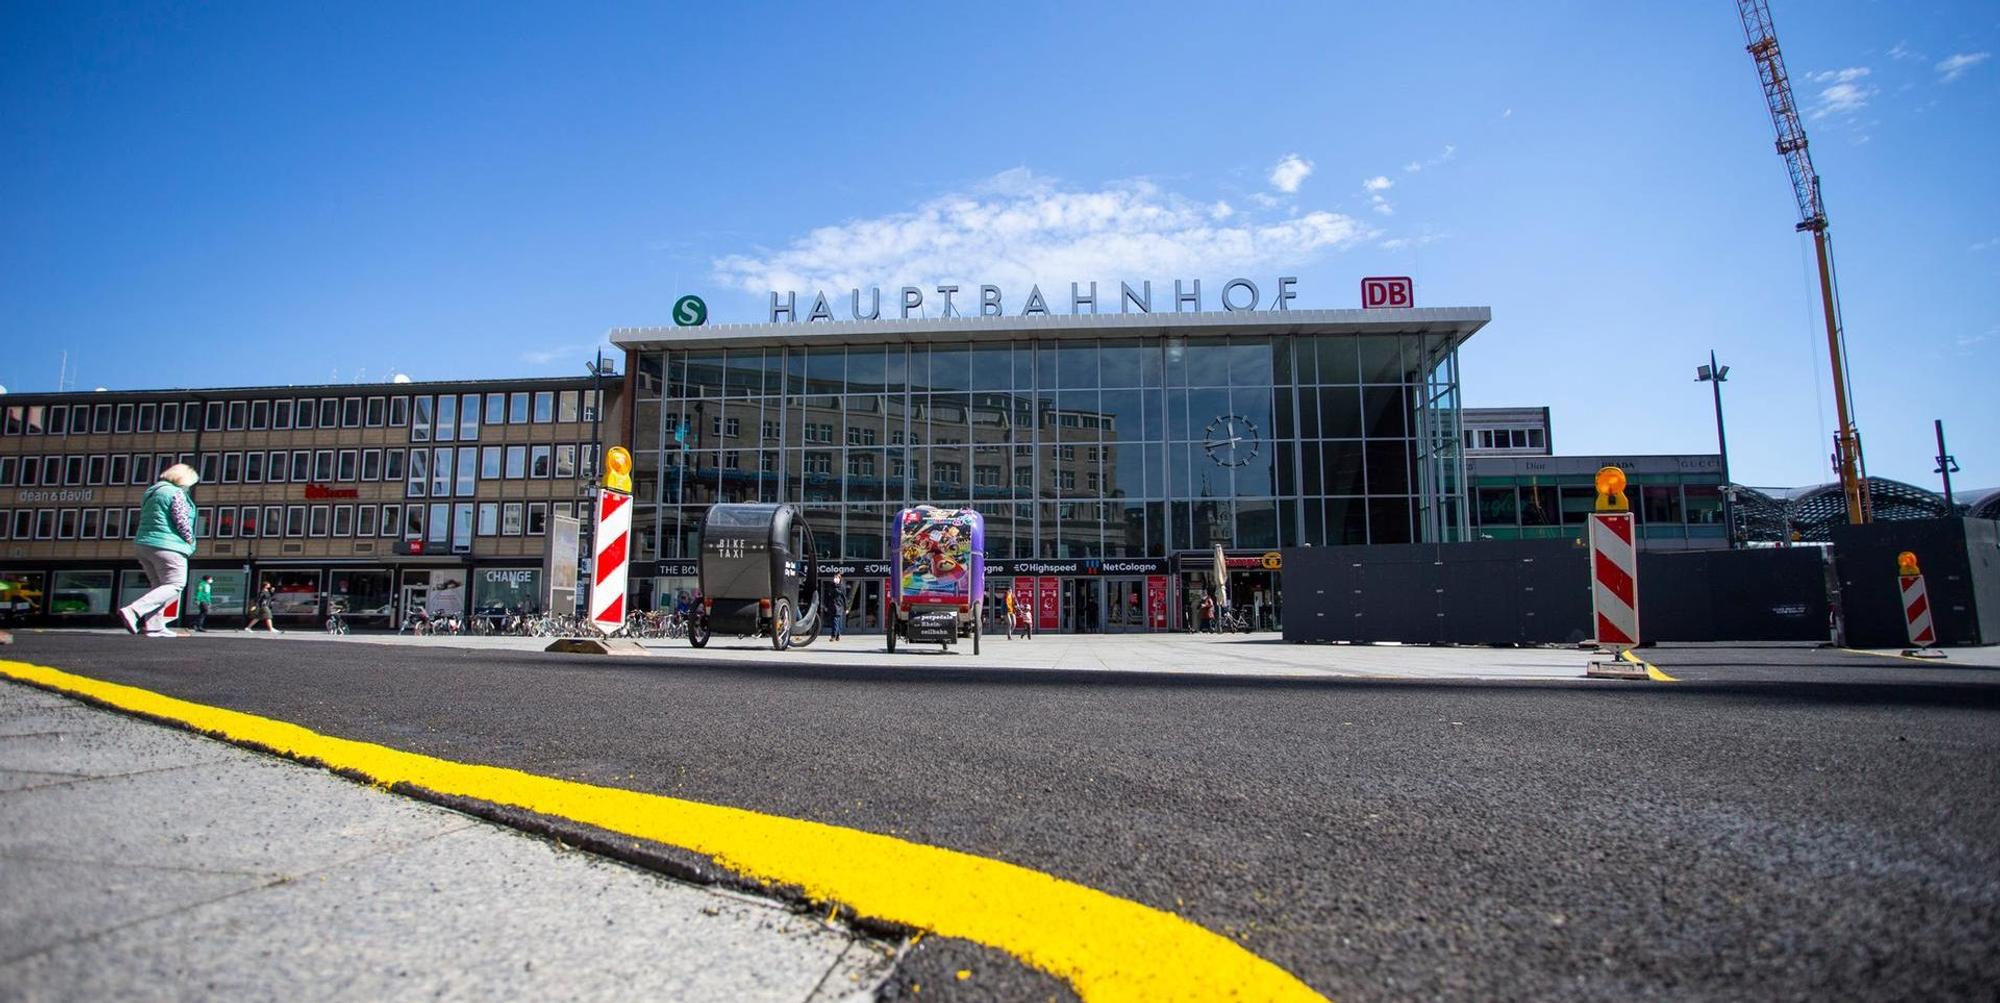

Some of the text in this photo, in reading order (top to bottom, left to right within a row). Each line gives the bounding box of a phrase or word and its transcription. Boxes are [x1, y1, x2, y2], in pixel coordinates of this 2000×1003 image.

[1368, 281, 1408, 305] DB
[768, 276, 1299, 324] HAUPTBAHNHOF
[678, 299, 701, 325] S
[1526, 461, 1545, 470] Dior
[20, 489, 48, 501] dean
[59, 488, 92, 501] david
[719, 539, 745, 548] BIKE
[719, 549, 744, 558] TAXI
[660, 565, 679, 575] THE
[1030, 563, 1077, 573] Highspeed
[1103, 562, 1156, 572] NetCologne
[487, 571, 532, 582] CHANGE
